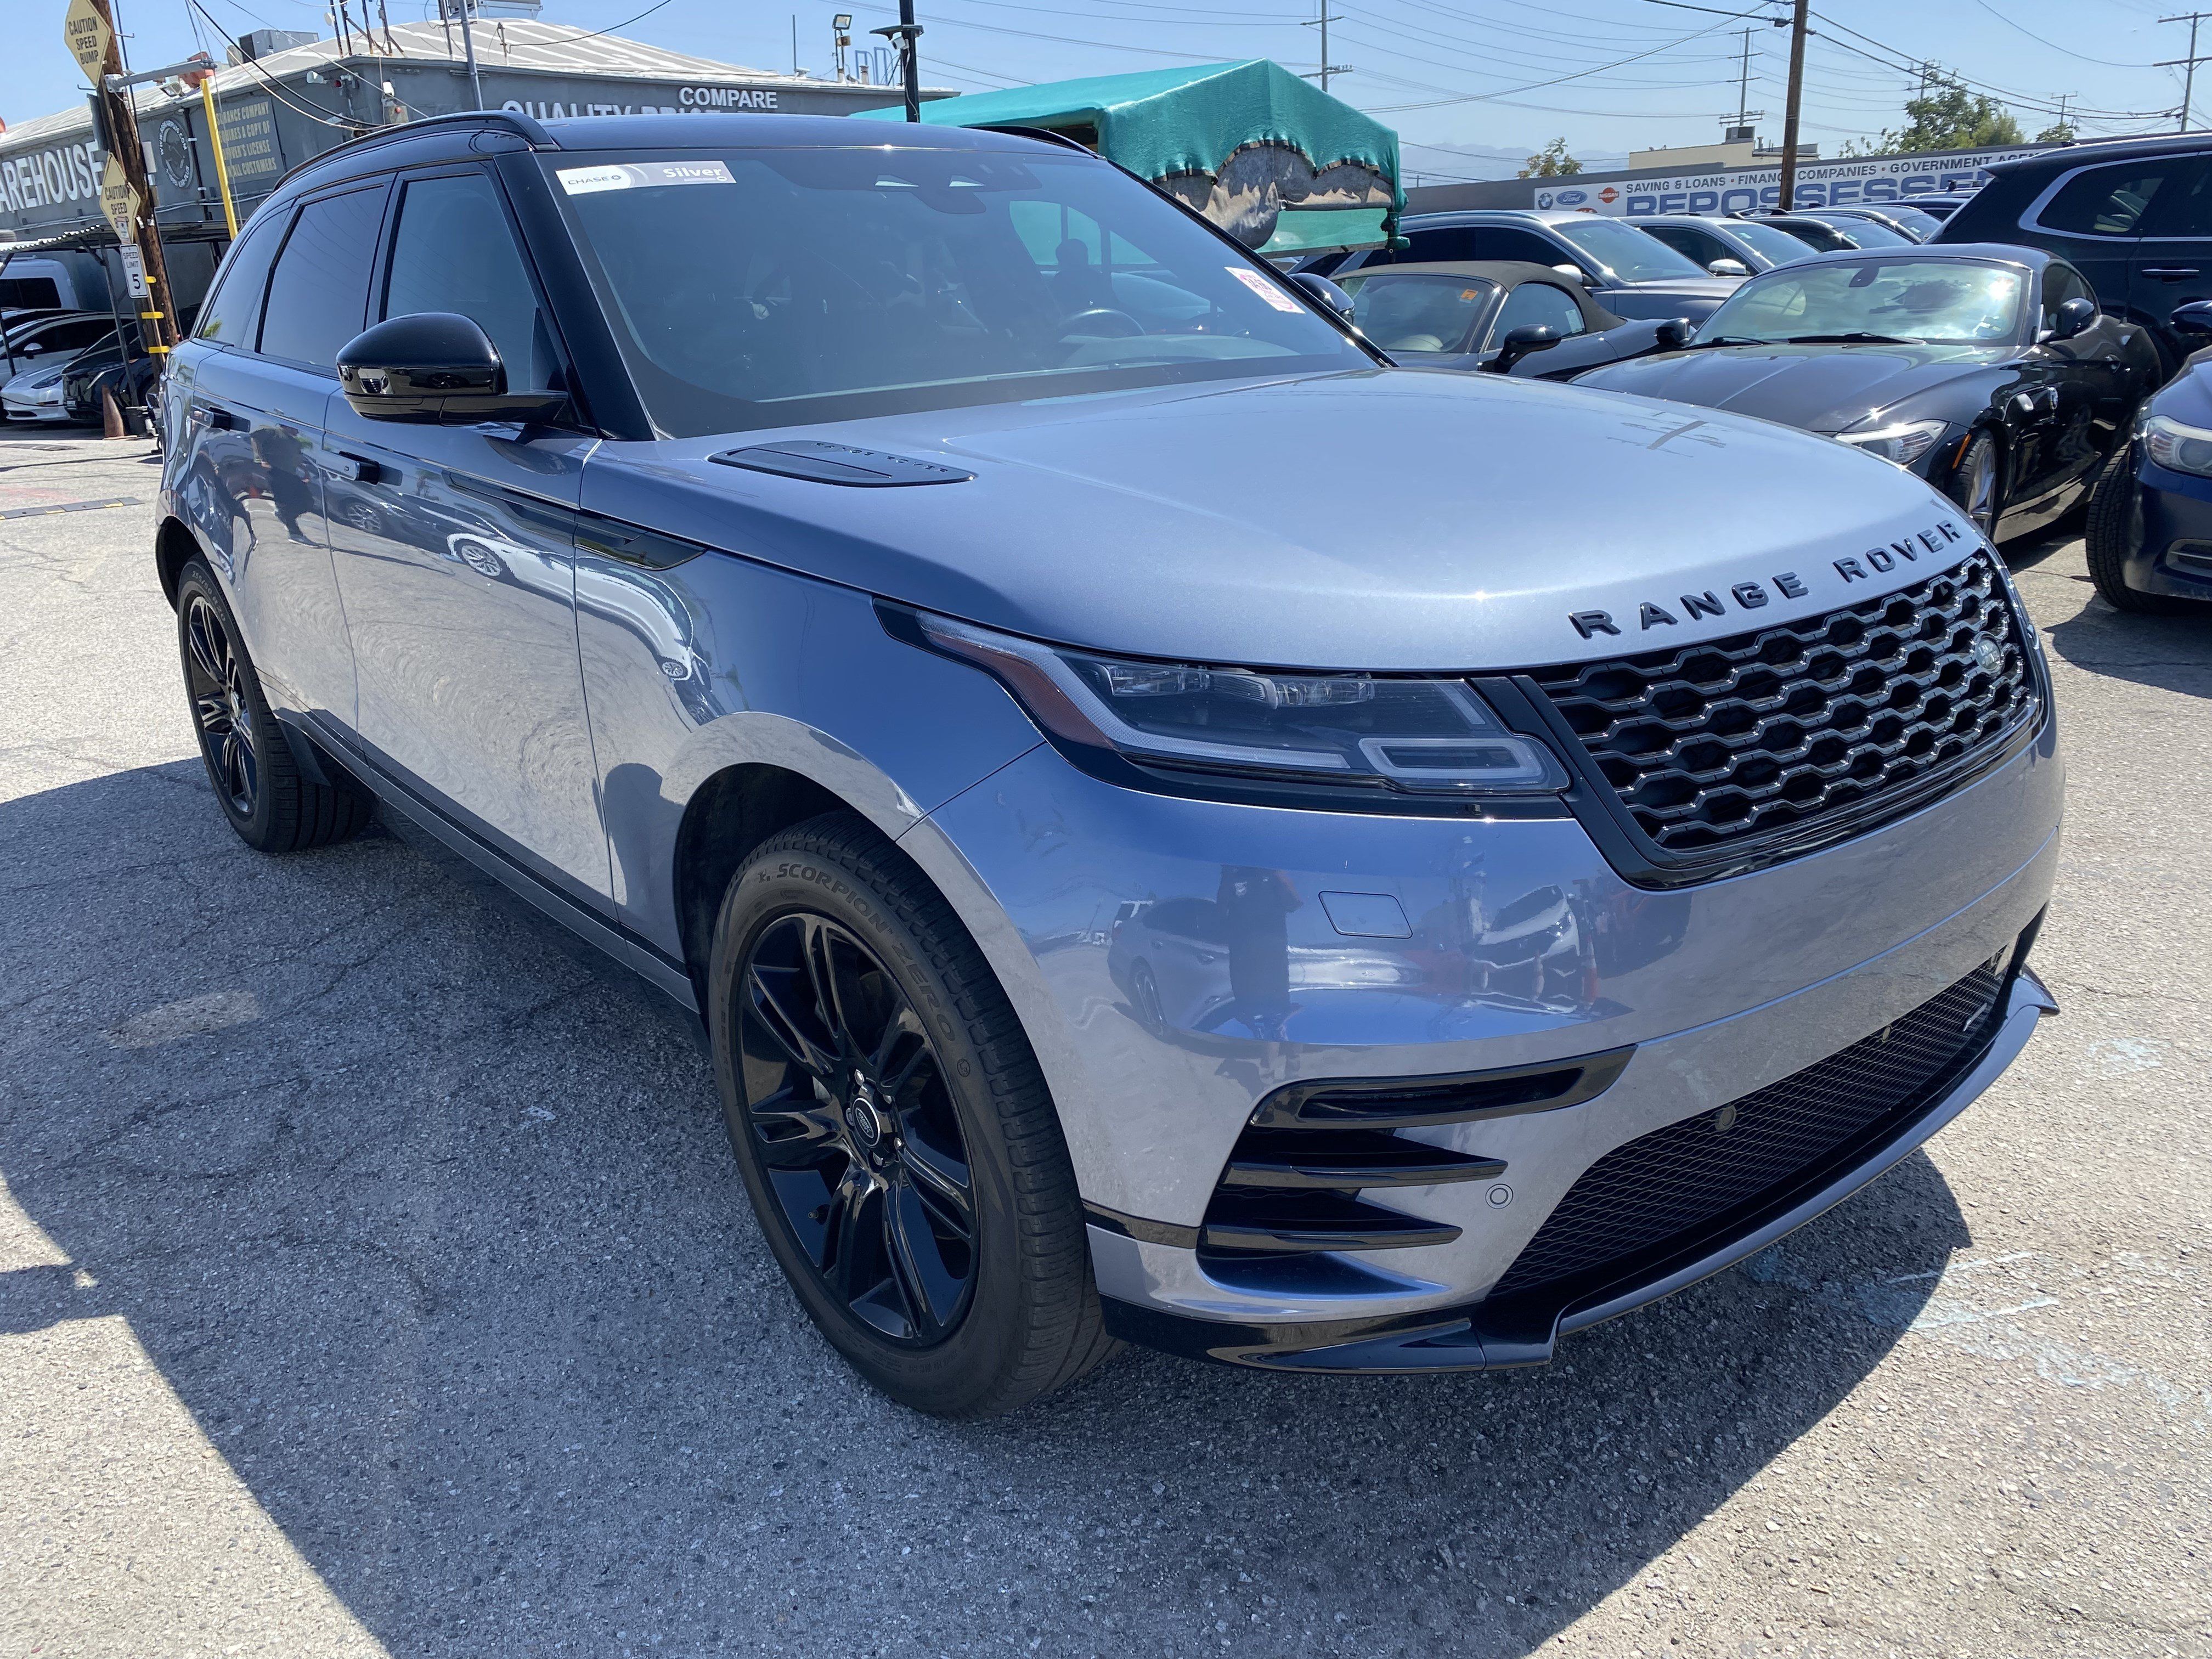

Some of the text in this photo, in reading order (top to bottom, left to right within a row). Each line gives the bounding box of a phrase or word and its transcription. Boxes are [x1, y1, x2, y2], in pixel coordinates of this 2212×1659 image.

[69, 16, 98, 36] CAUTION
[76, 35, 97, 50] SPEED
[80, 50, 98, 65] BUMP
[678, 87, 778, 109] COMPARE
[241, 101, 269, 120] COMPANY
[241, 126, 246, 138] A
[246, 122, 262, 138] COPY
[262, 120, 270, 134] OF
[246, 139, 271, 156] LICENSE
[241, 157, 277, 175] CUSTOMERS
[663, 167, 722, 178] Silver
[568, 176, 610, 185] CHASE
[1626, 180, 1670, 193] SAVING
[1674, 180, 1682, 189] &
[1685, 177, 1726, 189] LOANS
[1738, 172, 1783, 185] FINANC
[1798, 165, 1877, 180] COMPANIES
[1891, 156, 1993, 173] GOVERNMENT
[105, 184, 128, 200] CAUTION
[1562, 193, 1582, 202] Ford
[111, 202, 127, 215] SPEED
[114, 216, 129, 228] BP
[132, 274, 140, 289] 5
[1568, 519, 1963, 640] RANGE ROVER
[776, 863, 890, 934] SCORPION
[891, 943, 956, 1041] ZERO
